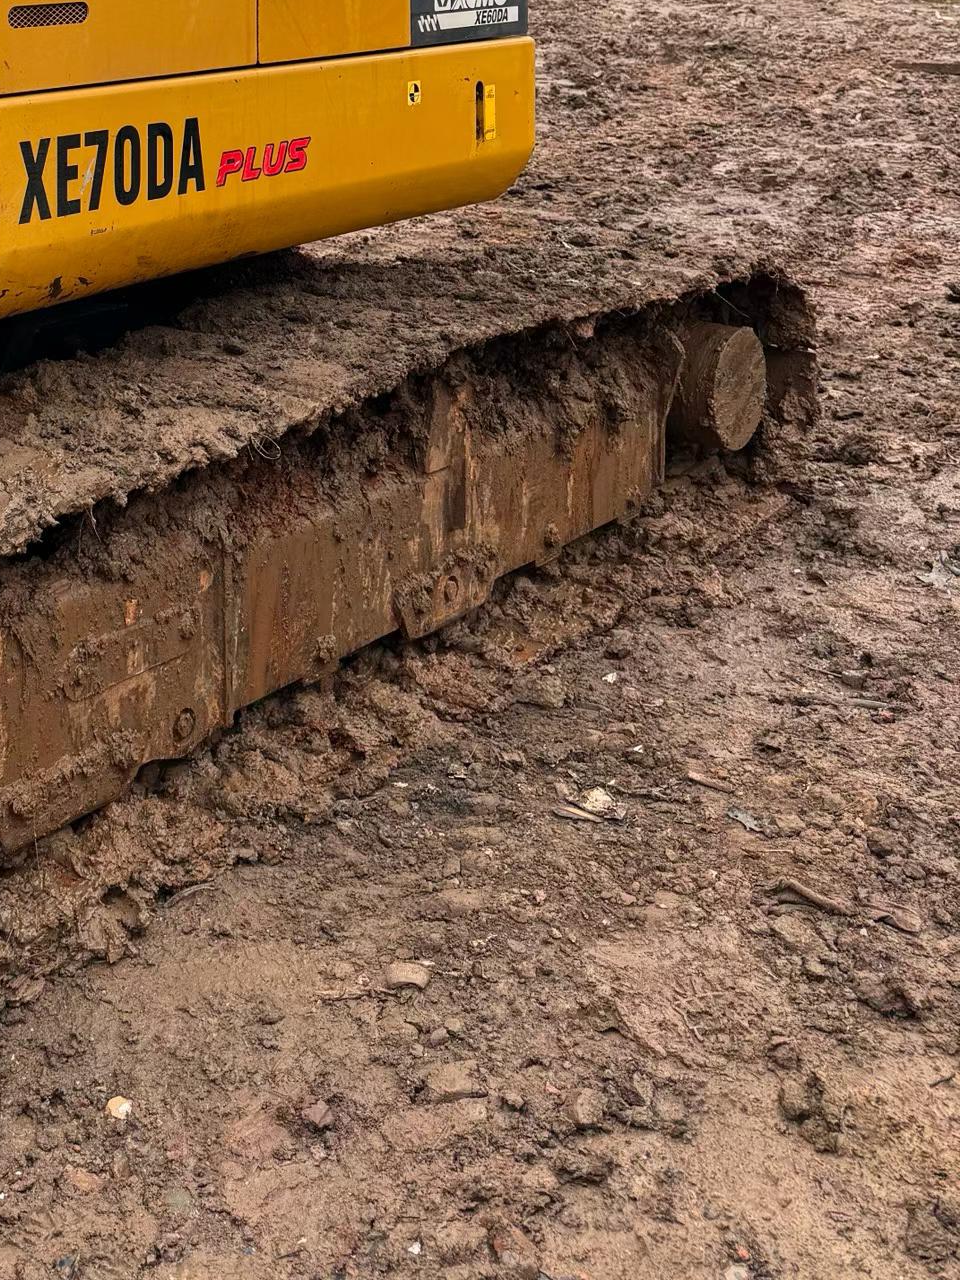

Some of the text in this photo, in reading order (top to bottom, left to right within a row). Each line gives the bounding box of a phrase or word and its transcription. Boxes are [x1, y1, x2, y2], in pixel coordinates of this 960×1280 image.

[475, 8, 509, 25] XE60DA
[19, 116, 312, 224] XE70DA PLUS
